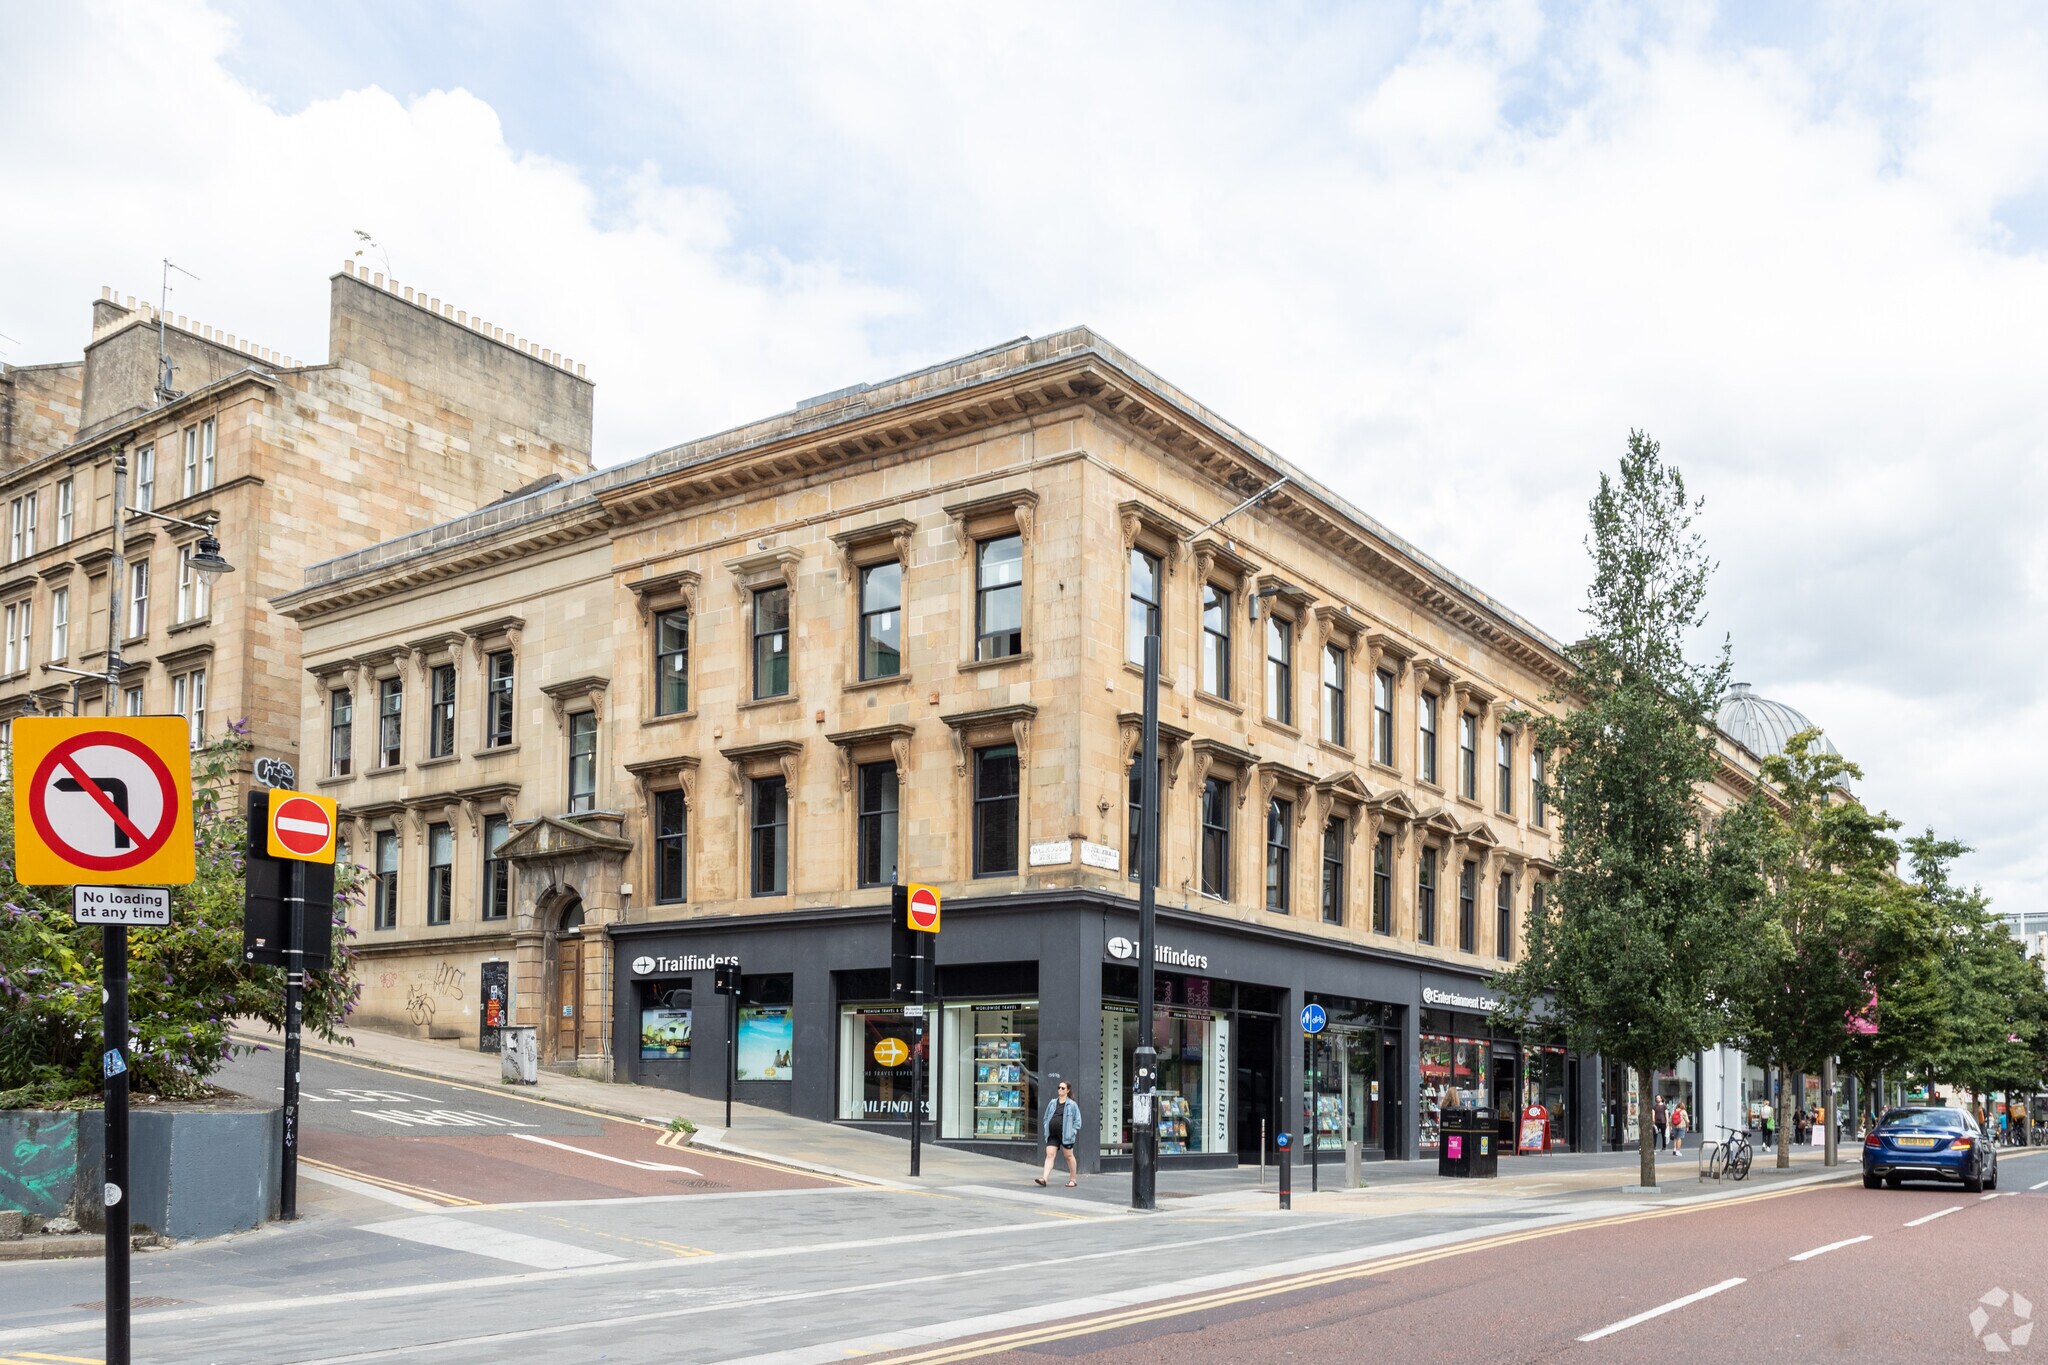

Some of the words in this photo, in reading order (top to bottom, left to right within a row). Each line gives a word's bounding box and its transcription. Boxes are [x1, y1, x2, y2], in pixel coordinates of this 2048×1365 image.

[83, 891, 104, 903] No
[110, 892, 162, 907] loading
[81, 906, 96, 917] at
[102, 908, 127, 920] any
[133, 907, 164, 919] time
[1133, 941, 1208, 969] Tilfinders
[1433, 989, 1480, 1009] Entertainment
[1218, 1034, 1226, 1141] TRAILFINDERS
[350, 1109, 541, 1127] TURN
